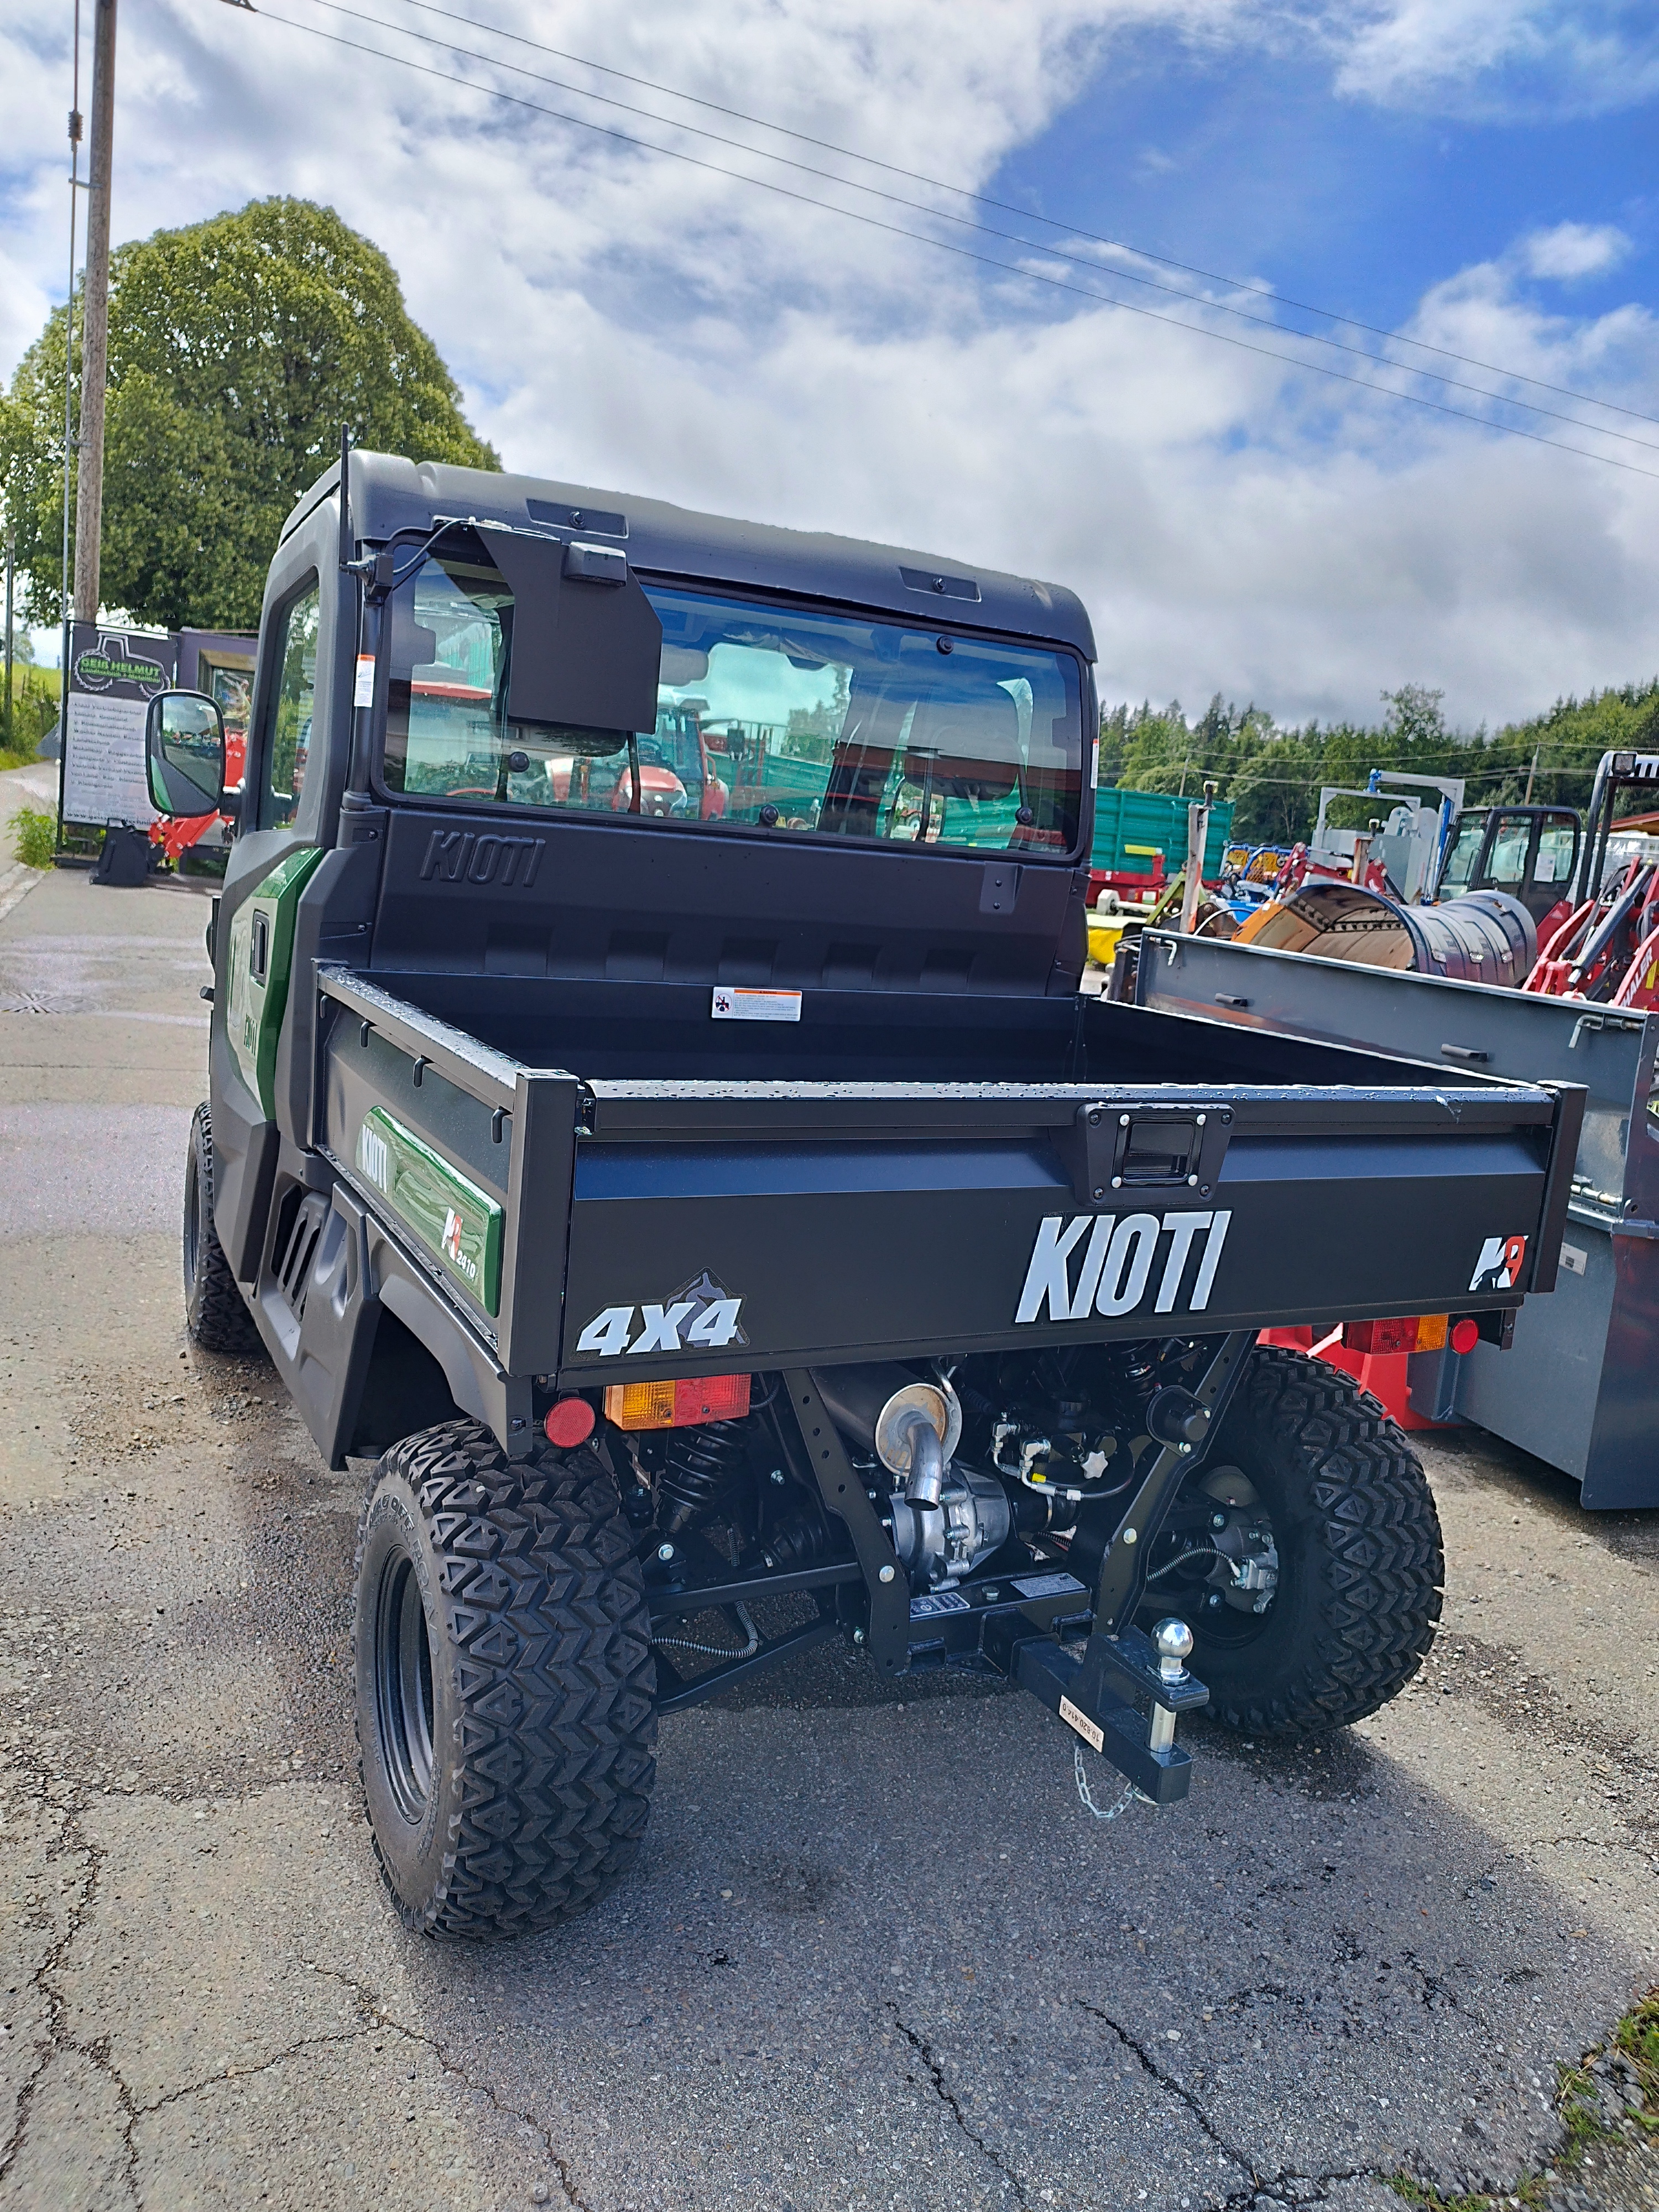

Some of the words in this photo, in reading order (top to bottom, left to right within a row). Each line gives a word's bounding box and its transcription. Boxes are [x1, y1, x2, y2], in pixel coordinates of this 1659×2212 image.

[111, 661, 160, 677] HELMUT
[419, 830, 546, 887] KIOTI
[1620, 945, 1653, 1007] HALER
[362, 1124, 388, 1193] KIOTI
[456, 1250, 476, 1279] 2410
[1015, 1210, 1233, 1323] KIOTI
